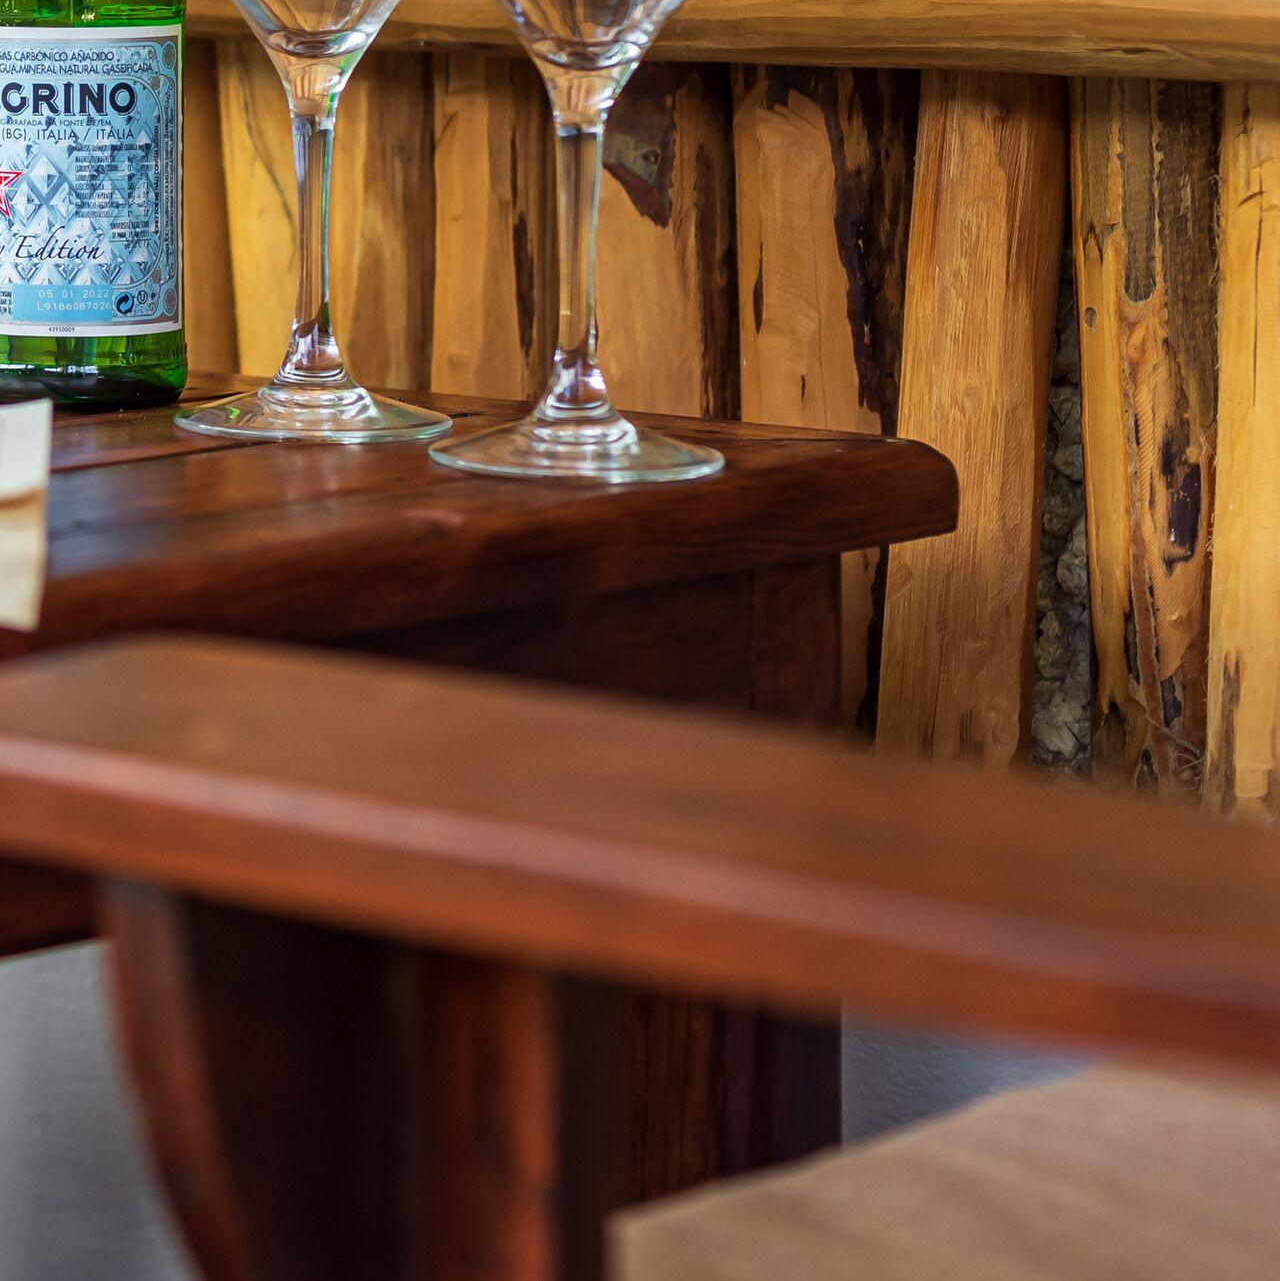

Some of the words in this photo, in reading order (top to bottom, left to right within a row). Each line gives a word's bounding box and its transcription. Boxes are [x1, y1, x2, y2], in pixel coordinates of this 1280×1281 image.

[60, 64, 100, 74] NATURAL
[37, 128, 77, 140] ITALIA
[15, 225, 104, 261] Edition
[83, 289, 109, 298] 2022
